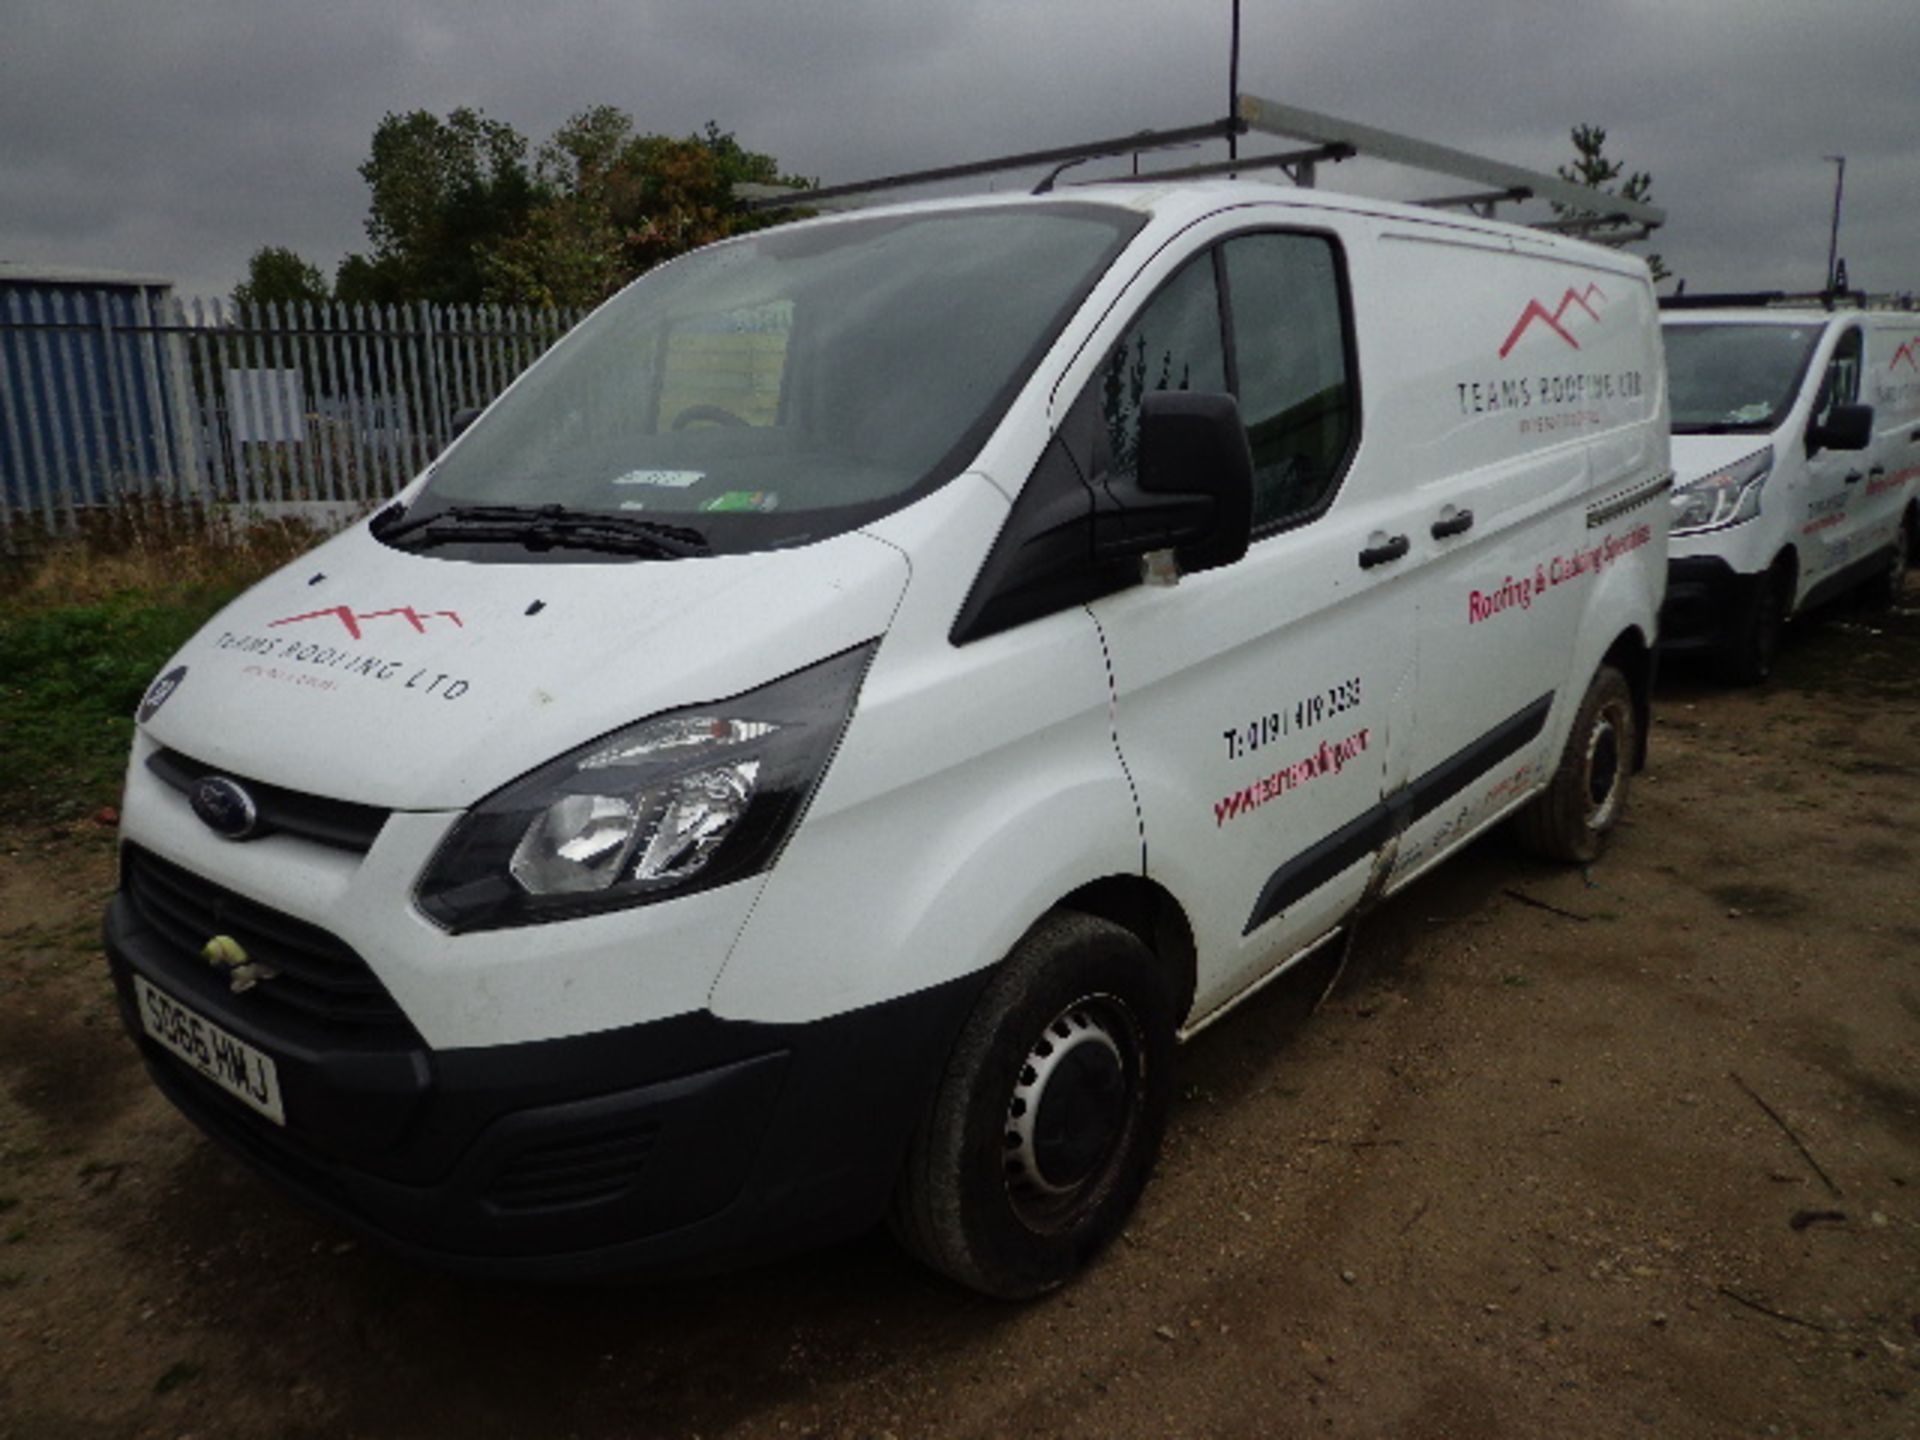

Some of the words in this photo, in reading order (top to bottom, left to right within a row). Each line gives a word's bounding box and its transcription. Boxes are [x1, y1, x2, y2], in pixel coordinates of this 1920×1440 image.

[1457, 377, 1531, 414] TEAMS
[1469, 576, 1531, 624] Roofing
[1536, 564, 1545, 594] &
[279, 641, 403, 680] ROOFING
[405, 668, 469, 700] LTD
[1224, 729, 1243, 759] T:
